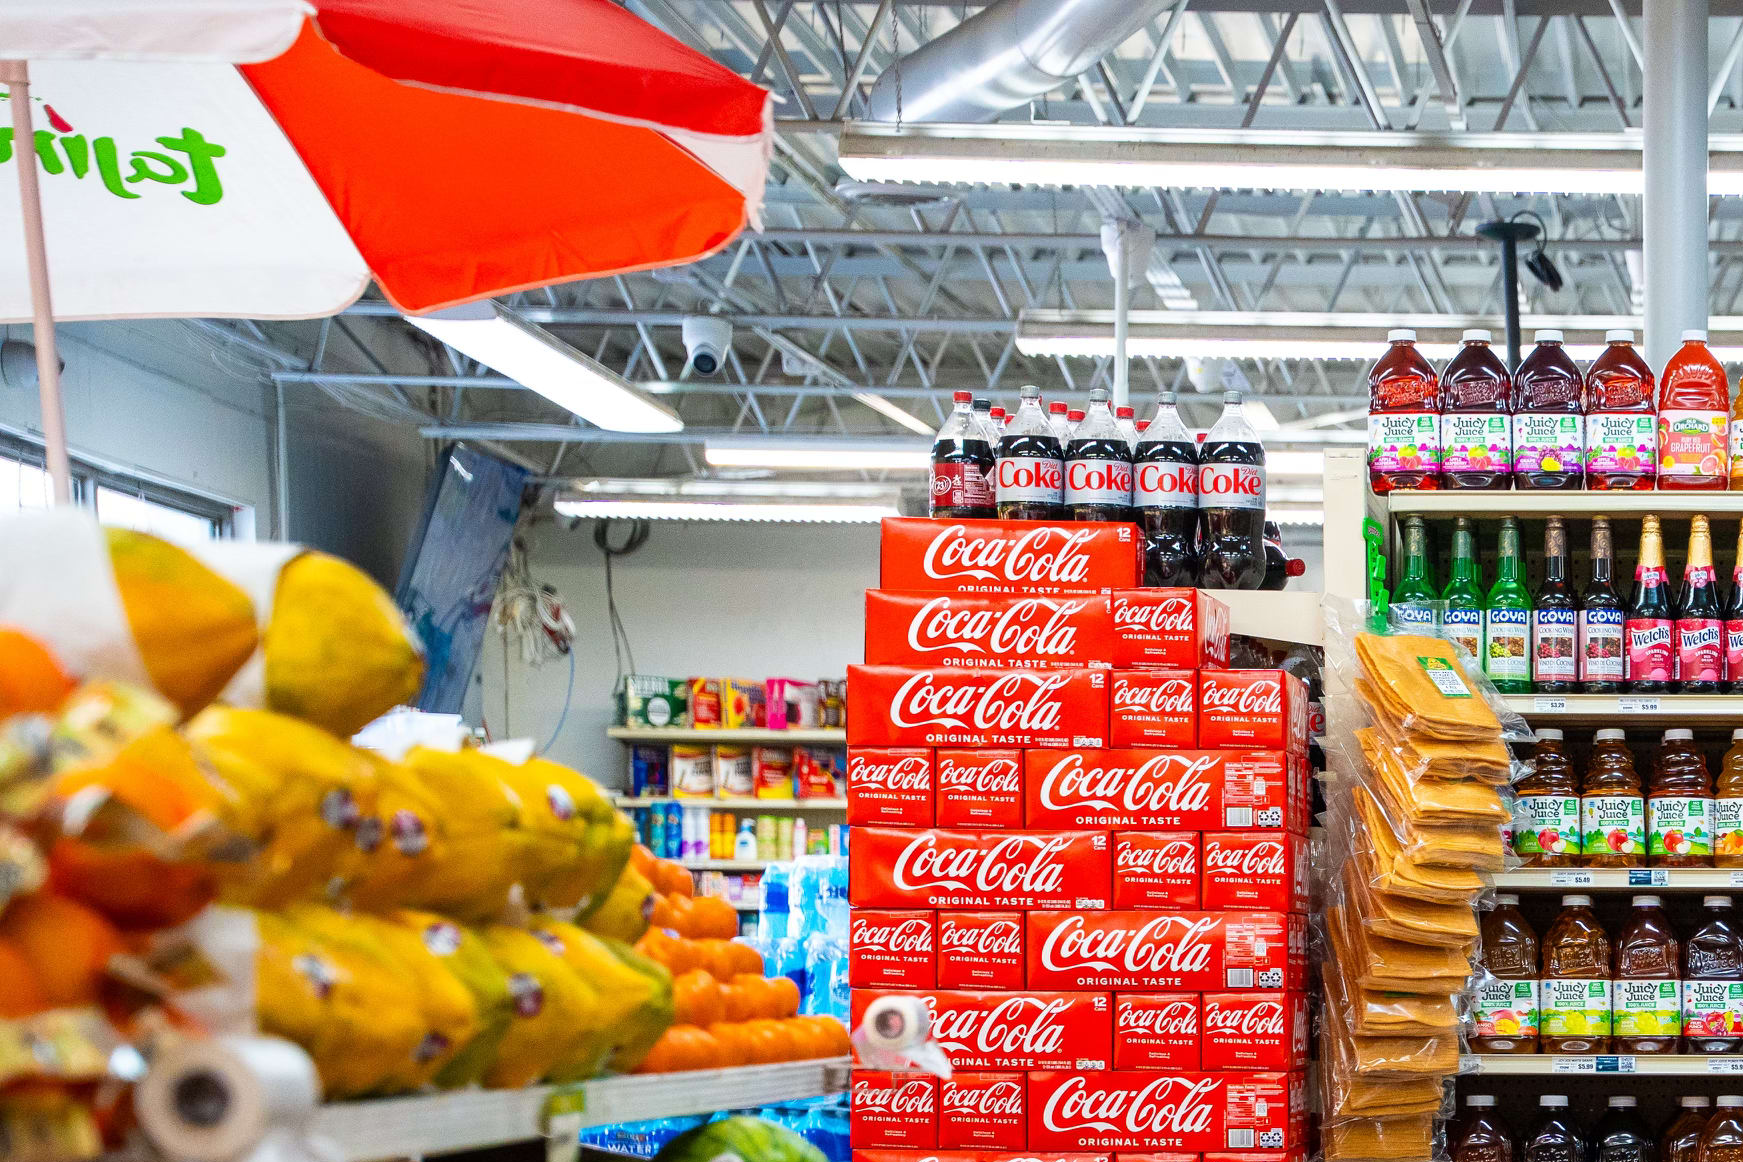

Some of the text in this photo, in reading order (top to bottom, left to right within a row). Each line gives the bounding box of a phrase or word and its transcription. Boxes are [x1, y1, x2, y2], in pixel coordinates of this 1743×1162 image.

[1381, 417, 1415, 429] Juicy
[1453, 417, 1487, 429] Juicy
[1384, 427, 1413, 436] Juice
[1455, 427, 1484, 436] Juice
[999, 461, 1062, 490] Coke
[1069, 463, 1131, 491] Coke
[1140, 465, 1199, 493] Coke
[1200, 465, 1262, 495] Coke
[1117, 528, 1130, 537] 12
[921, 525, 1100, 582] Coca-Cola
[1445, 611, 1479, 623] GOYA
[1491, 611, 1526, 623] GOYA
[1540, 611, 1573, 623] GOYA
[1588, 611, 1622, 623] GOYA
[906, 597, 1086, 654] Coca-Cola
[1633, 627, 1670, 647] Welch's
[1683, 627, 1719, 647] Welch's
[943, 658, 1046, 668] ORIGINAL TASTE
[1090, 674, 1104, 683] 12
[888, 669, 1073, 730] Coca-Cola
[926, 734, 987, 743] ORIGINAL
[1041, 754, 1223, 810] Coca-Cola
[1529, 799, 1563, 812] Juicy
[1597, 799, 1631, 812] Juicy
[1656, 800, 1687, 813] Juicy
[1531, 810, 1560, 819] Juice
[1599, 810, 1628, 819] Juice
[1658, 811, 1684, 820] Juice
[1092, 836, 1106, 845] 12
[891, 832, 1077, 891] Coca-Cola
[929, 896, 988, 904] ORIGINAL
[1042, 916, 1222, 971] Coca-Cola
[1553, 981, 1588, 994] Juicy
[1624, 982, 1659, 995] Juicy
[1093, 997, 1106, 1006] 12
[1556, 991, 1585, 1000] Juice
[1626, 992, 1655, 1002] Juice
[920, 995, 1077, 1054] oca-Cola
[1044, 1077, 1226, 1132] Coca-Cola
